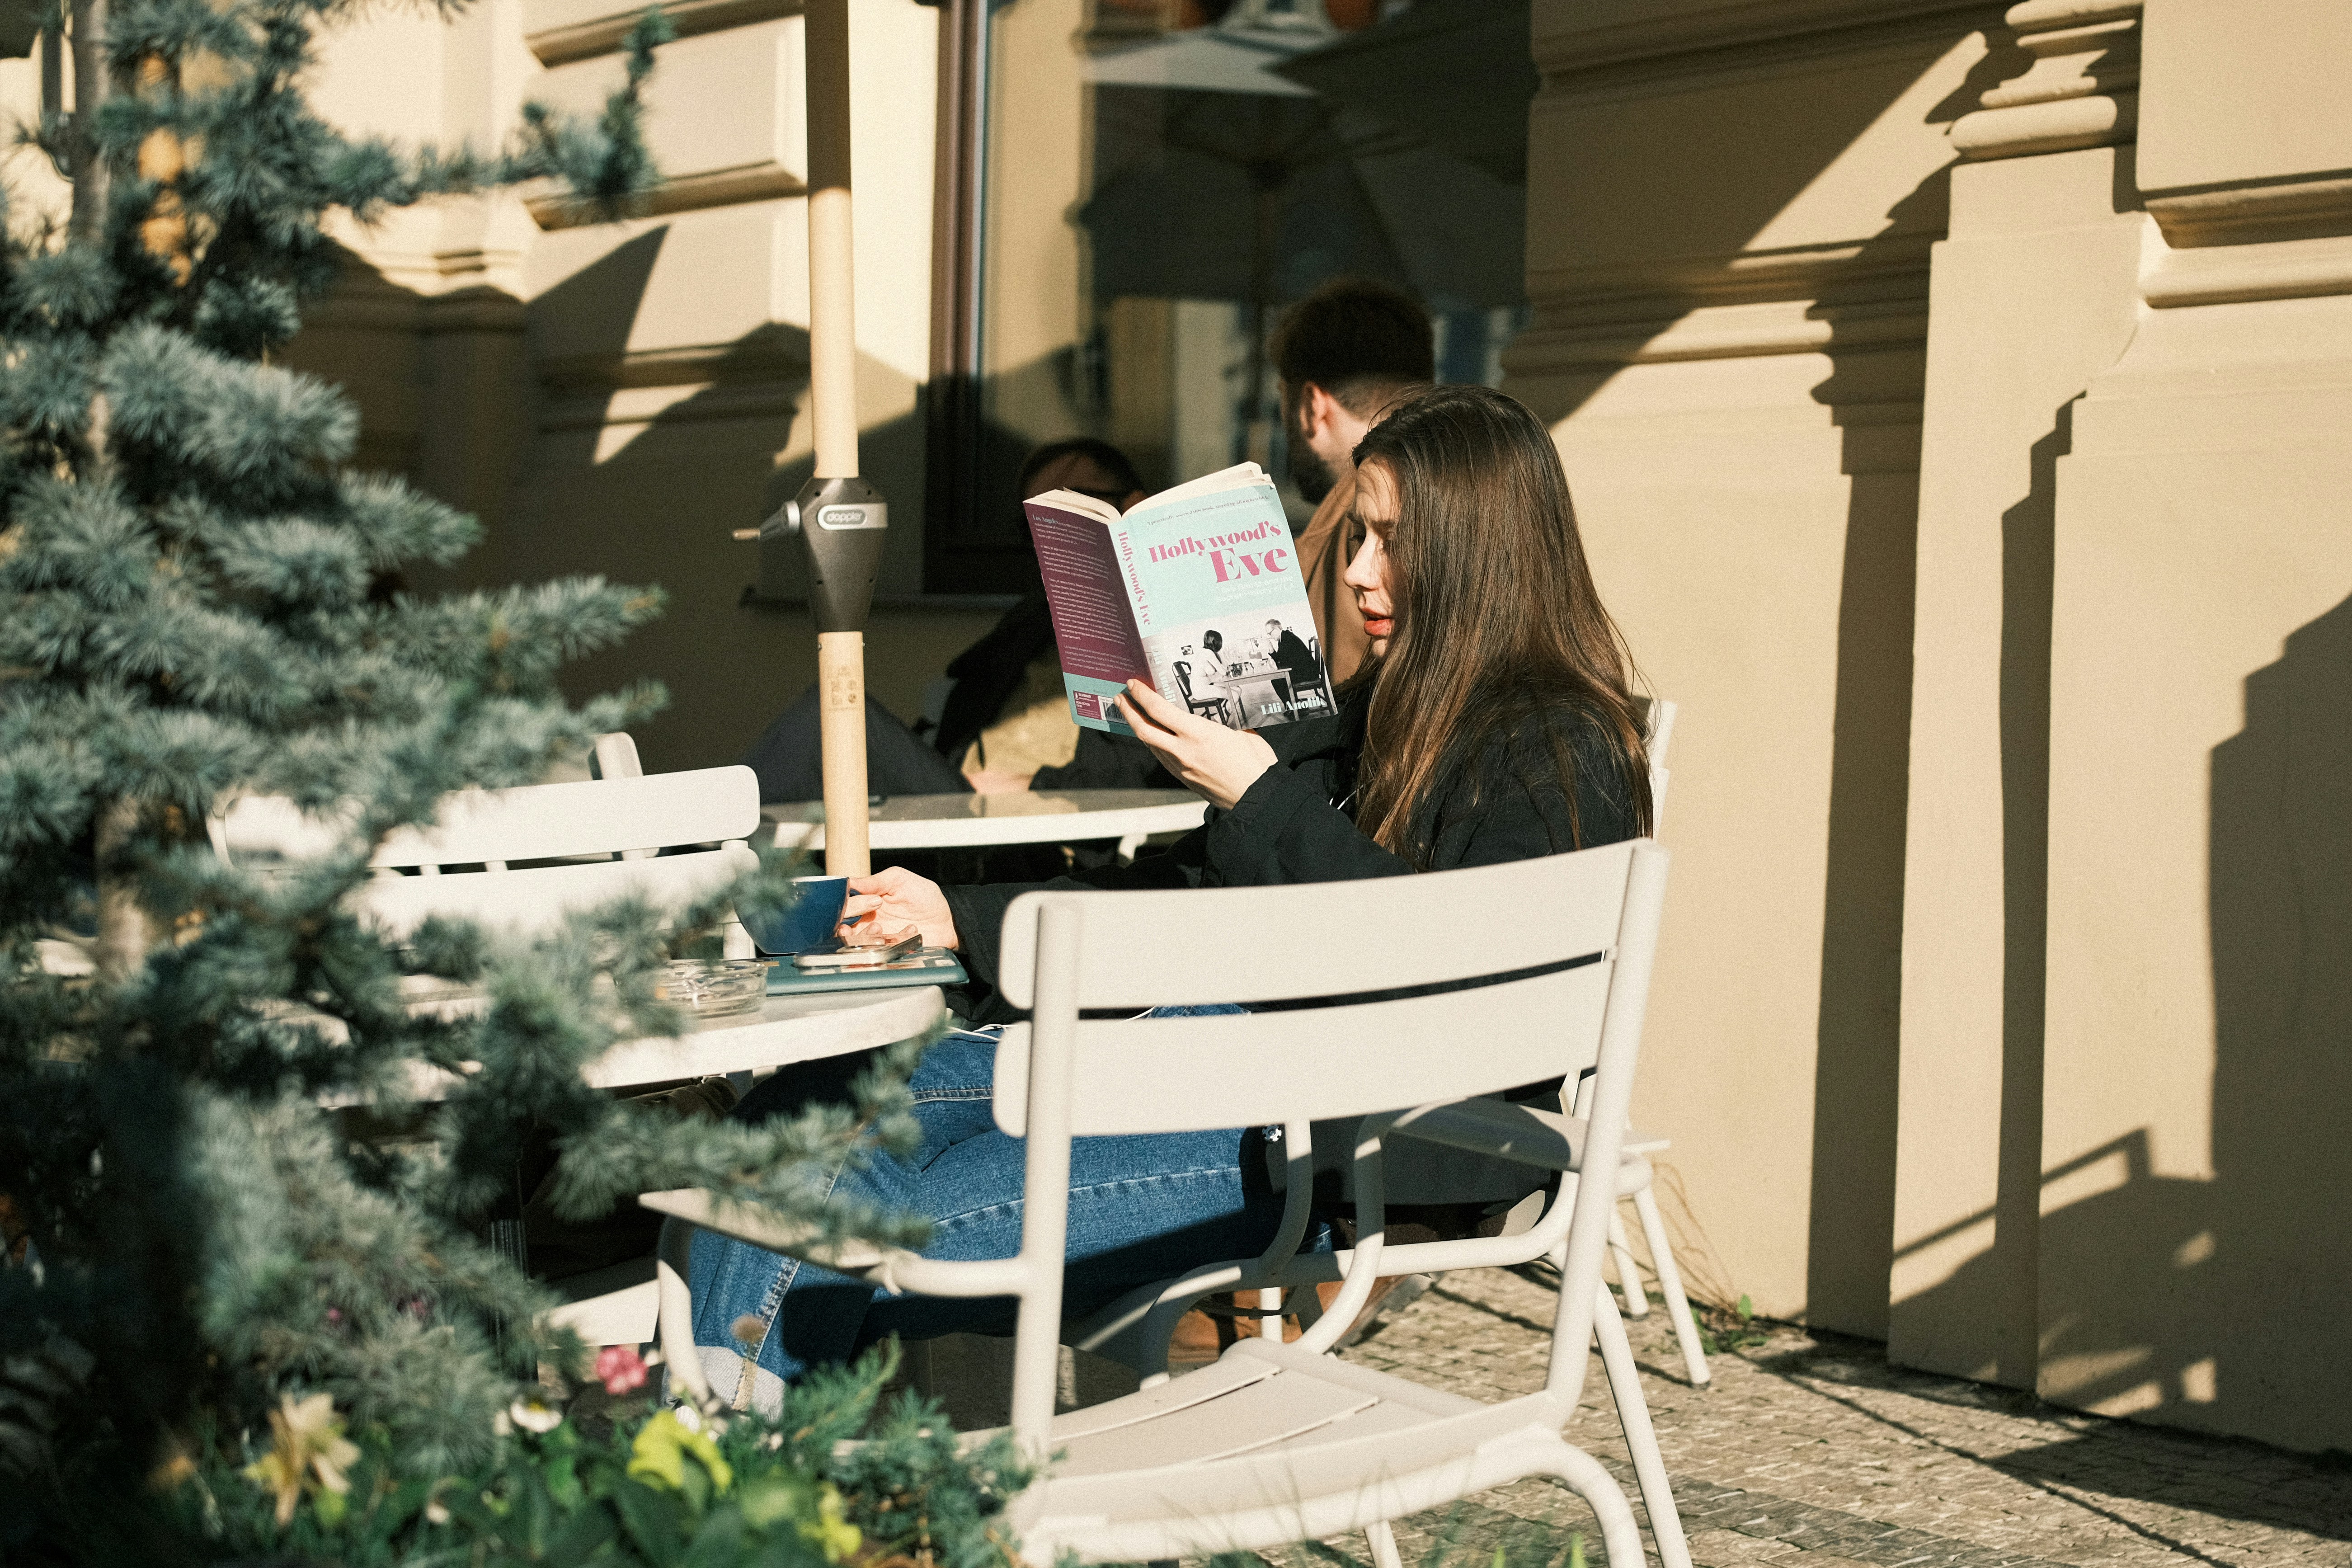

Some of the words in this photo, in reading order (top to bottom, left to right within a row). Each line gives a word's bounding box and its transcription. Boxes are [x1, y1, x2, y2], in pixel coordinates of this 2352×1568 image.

[826, 512, 862, 522] doppler
[1151, 515, 1174, 525] practically
[1148, 520, 1281, 563] Hollywood's
[1208, 547, 1288, 583] Eve
[1118, 532, 1145, 602] Hollywood's
[1139, 605, 1151, 626] Eve
[1244, 588, 1272, 597] History
[1151, 645, 1163, 665] Lili
[1260, 702, 1282, 715] Lili
[1285, 696, 1327, 711] Anolik
